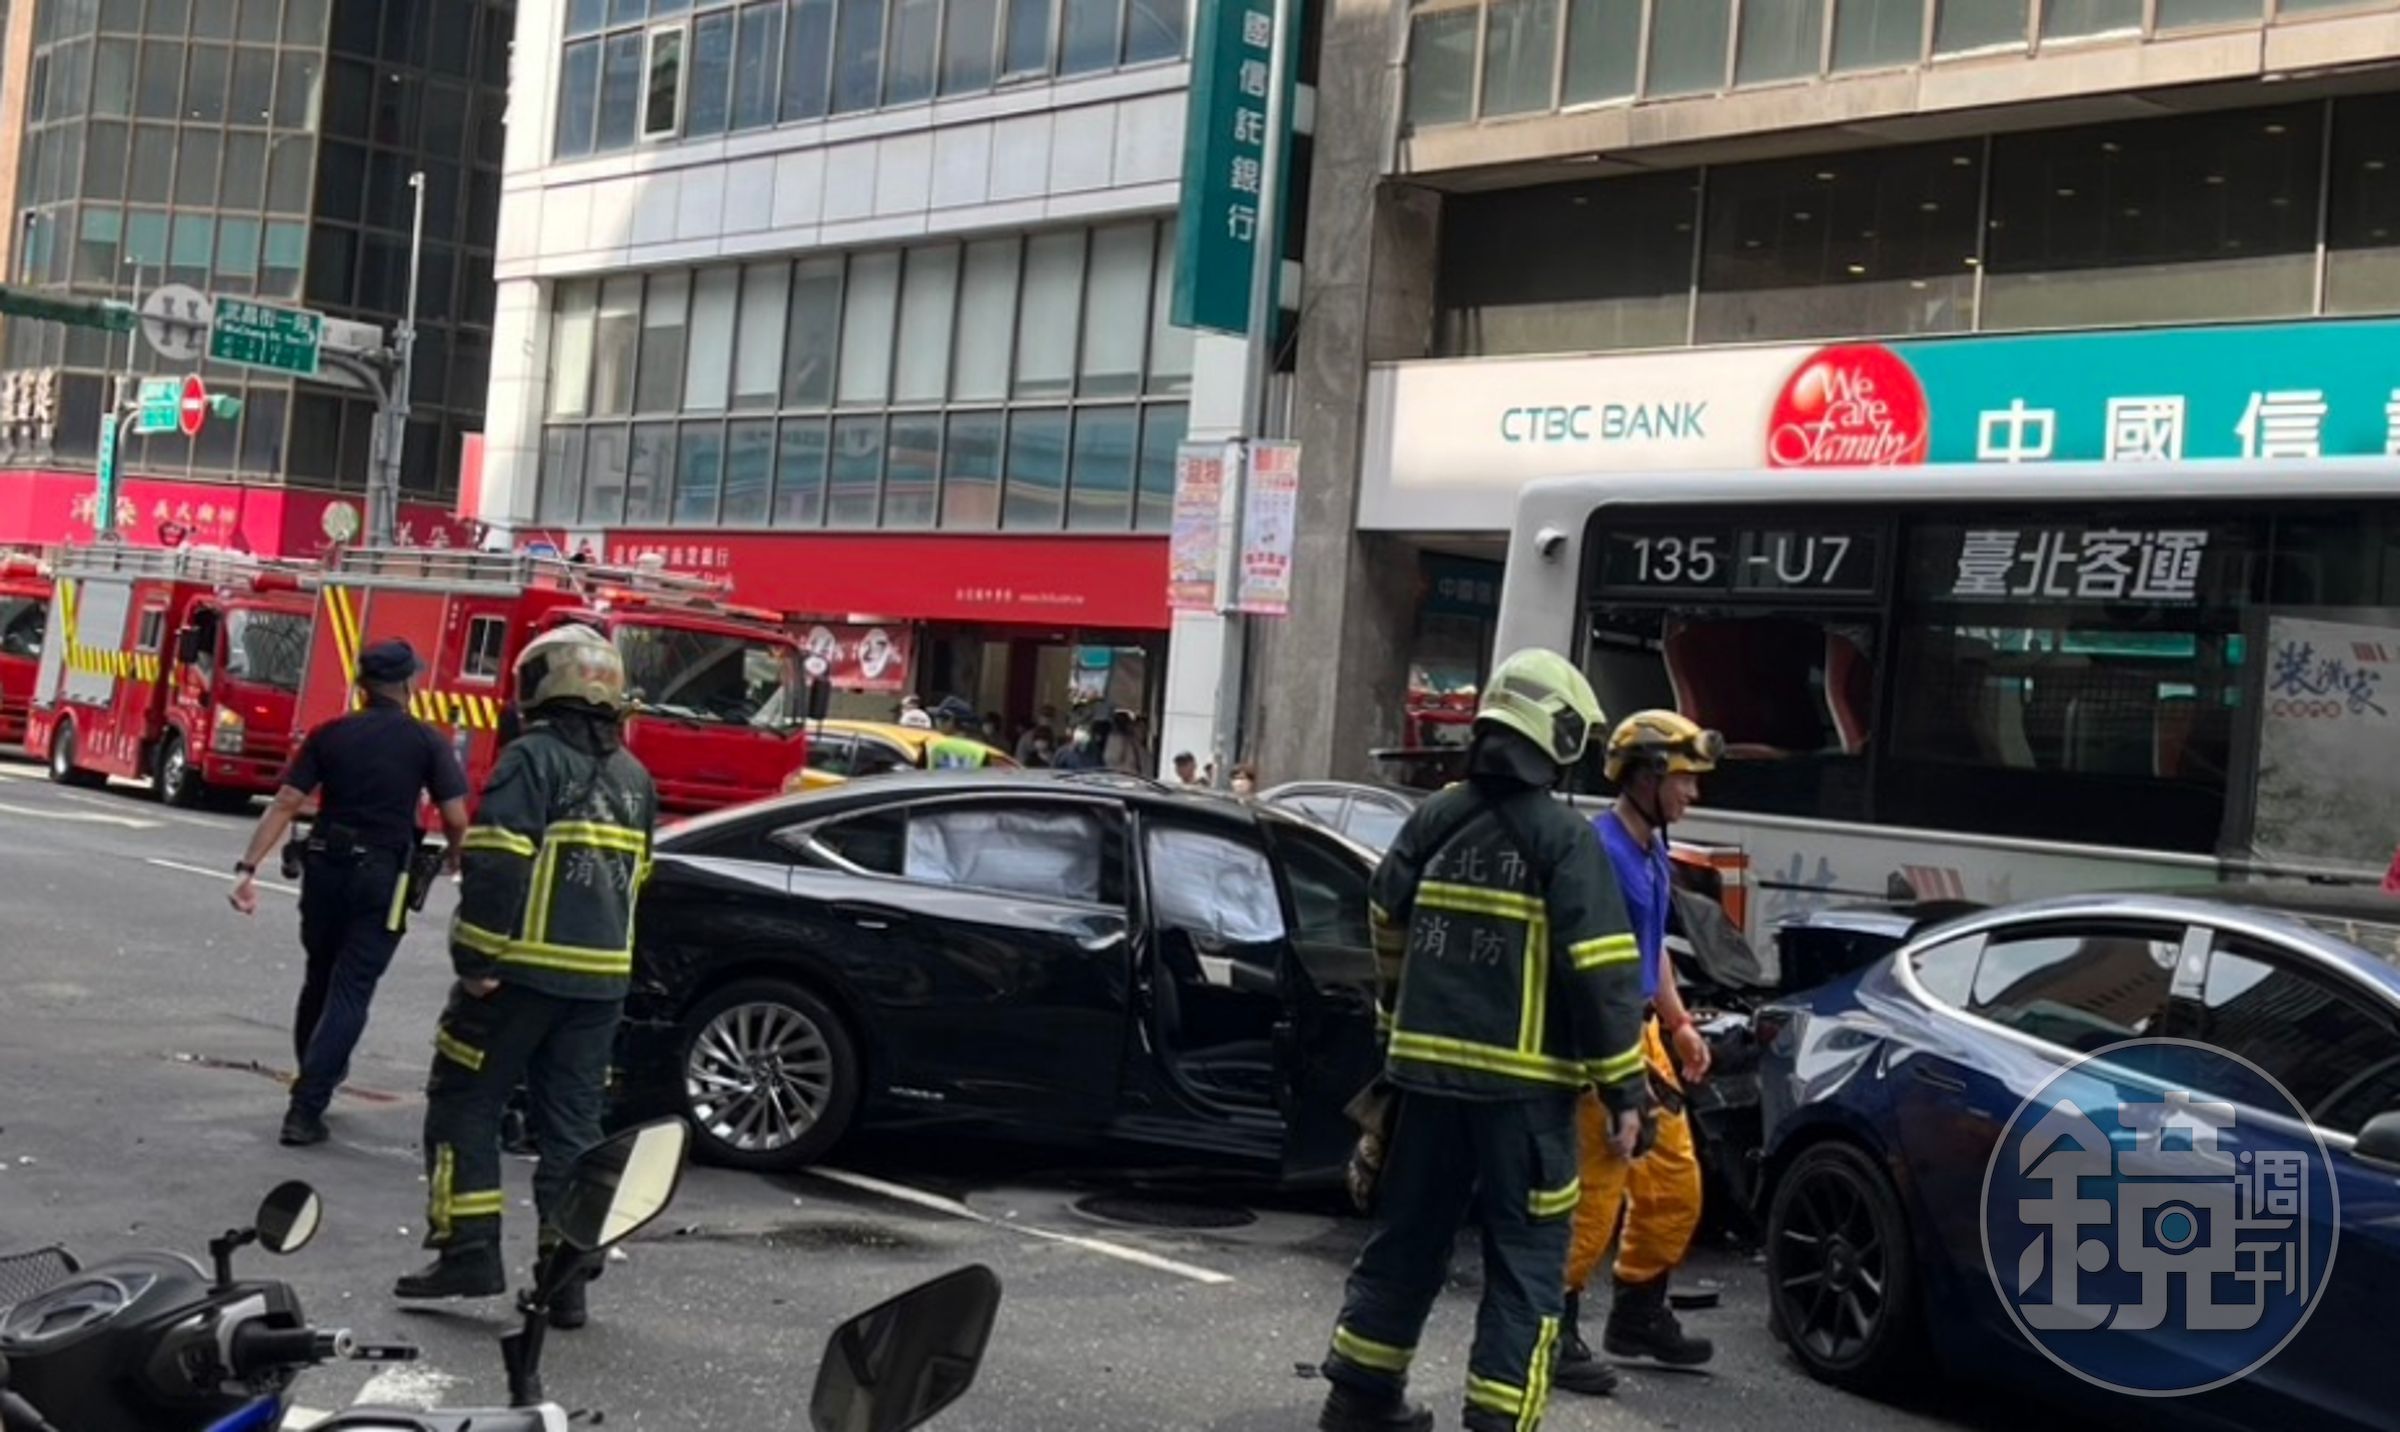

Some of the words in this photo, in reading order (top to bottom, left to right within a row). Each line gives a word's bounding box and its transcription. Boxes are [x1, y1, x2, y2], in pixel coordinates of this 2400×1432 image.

[1819, 365, 1874, 403] We
[1500, 403, 1592, 444] CTBC
[1600, 401, 1708, 441] BANK
[1769, 420, 1922, 466] Family
[1633, 536, 1716, 581] 135
[1951, 527, 2209, 600] 臺北客運
[1414, 915, 1507, 966] 消防
